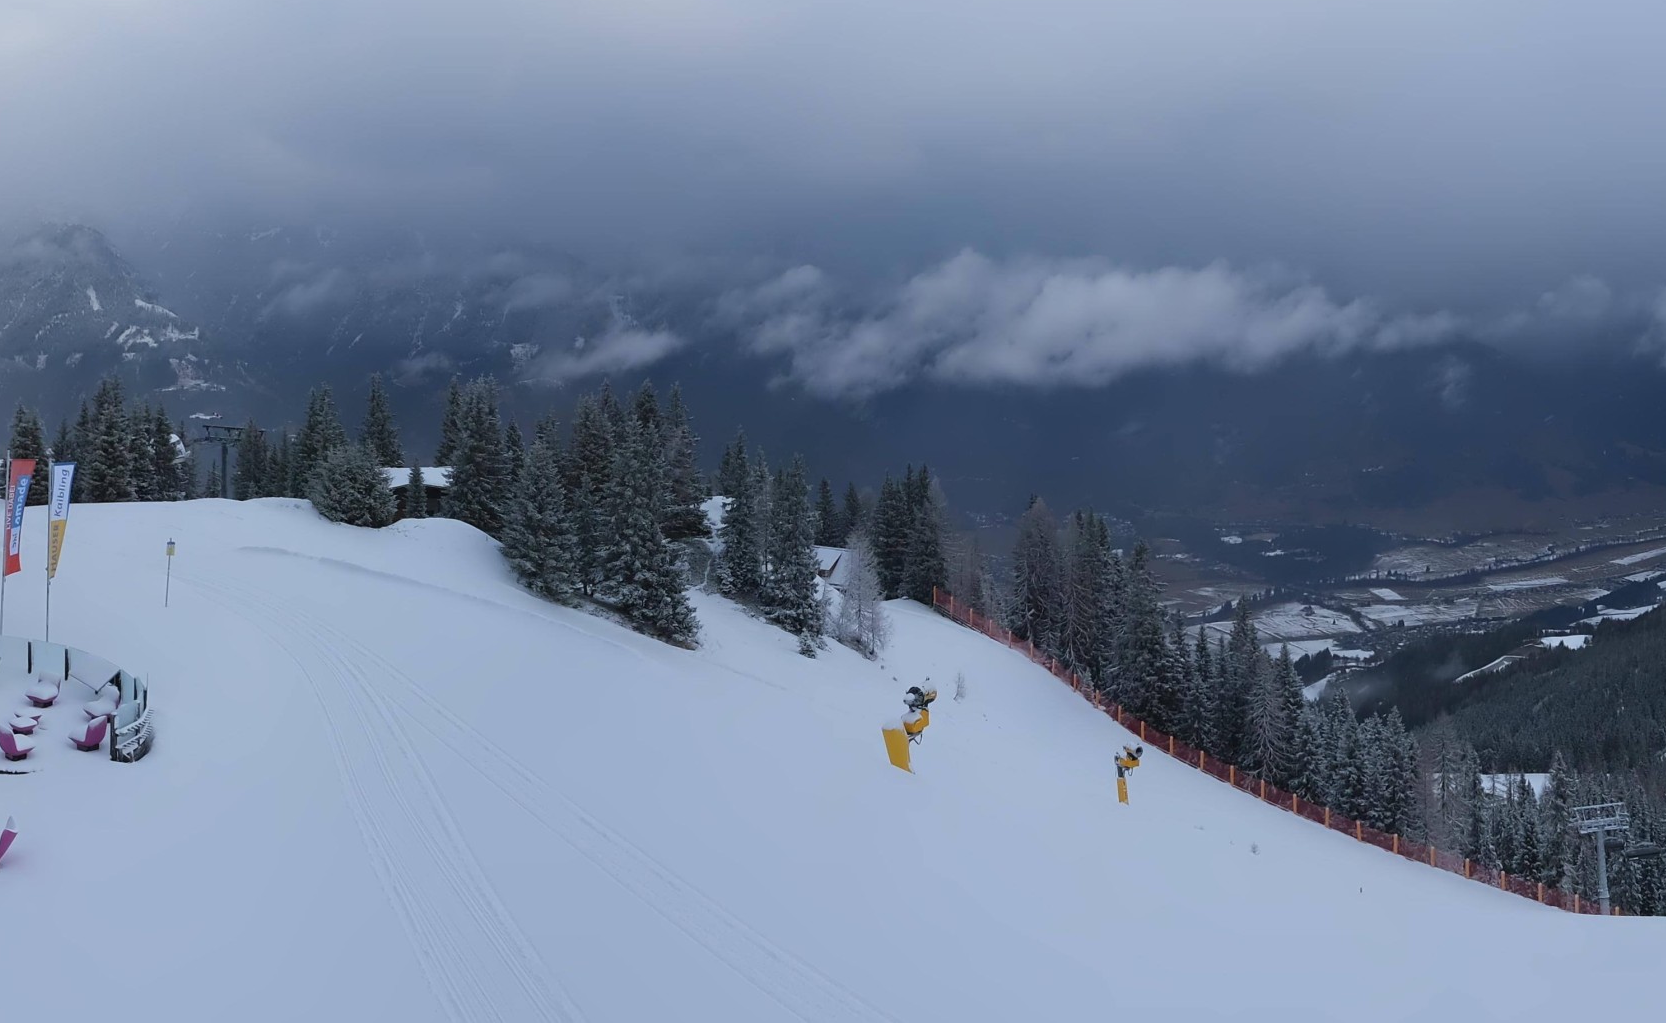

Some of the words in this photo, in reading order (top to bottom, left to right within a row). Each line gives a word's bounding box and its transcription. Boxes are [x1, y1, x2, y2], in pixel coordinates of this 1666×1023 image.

[7, 485, 15, 510] DABEI
[54, 469, 70, 517] Kaibling
[6, 511, 14, 530] LIVE
